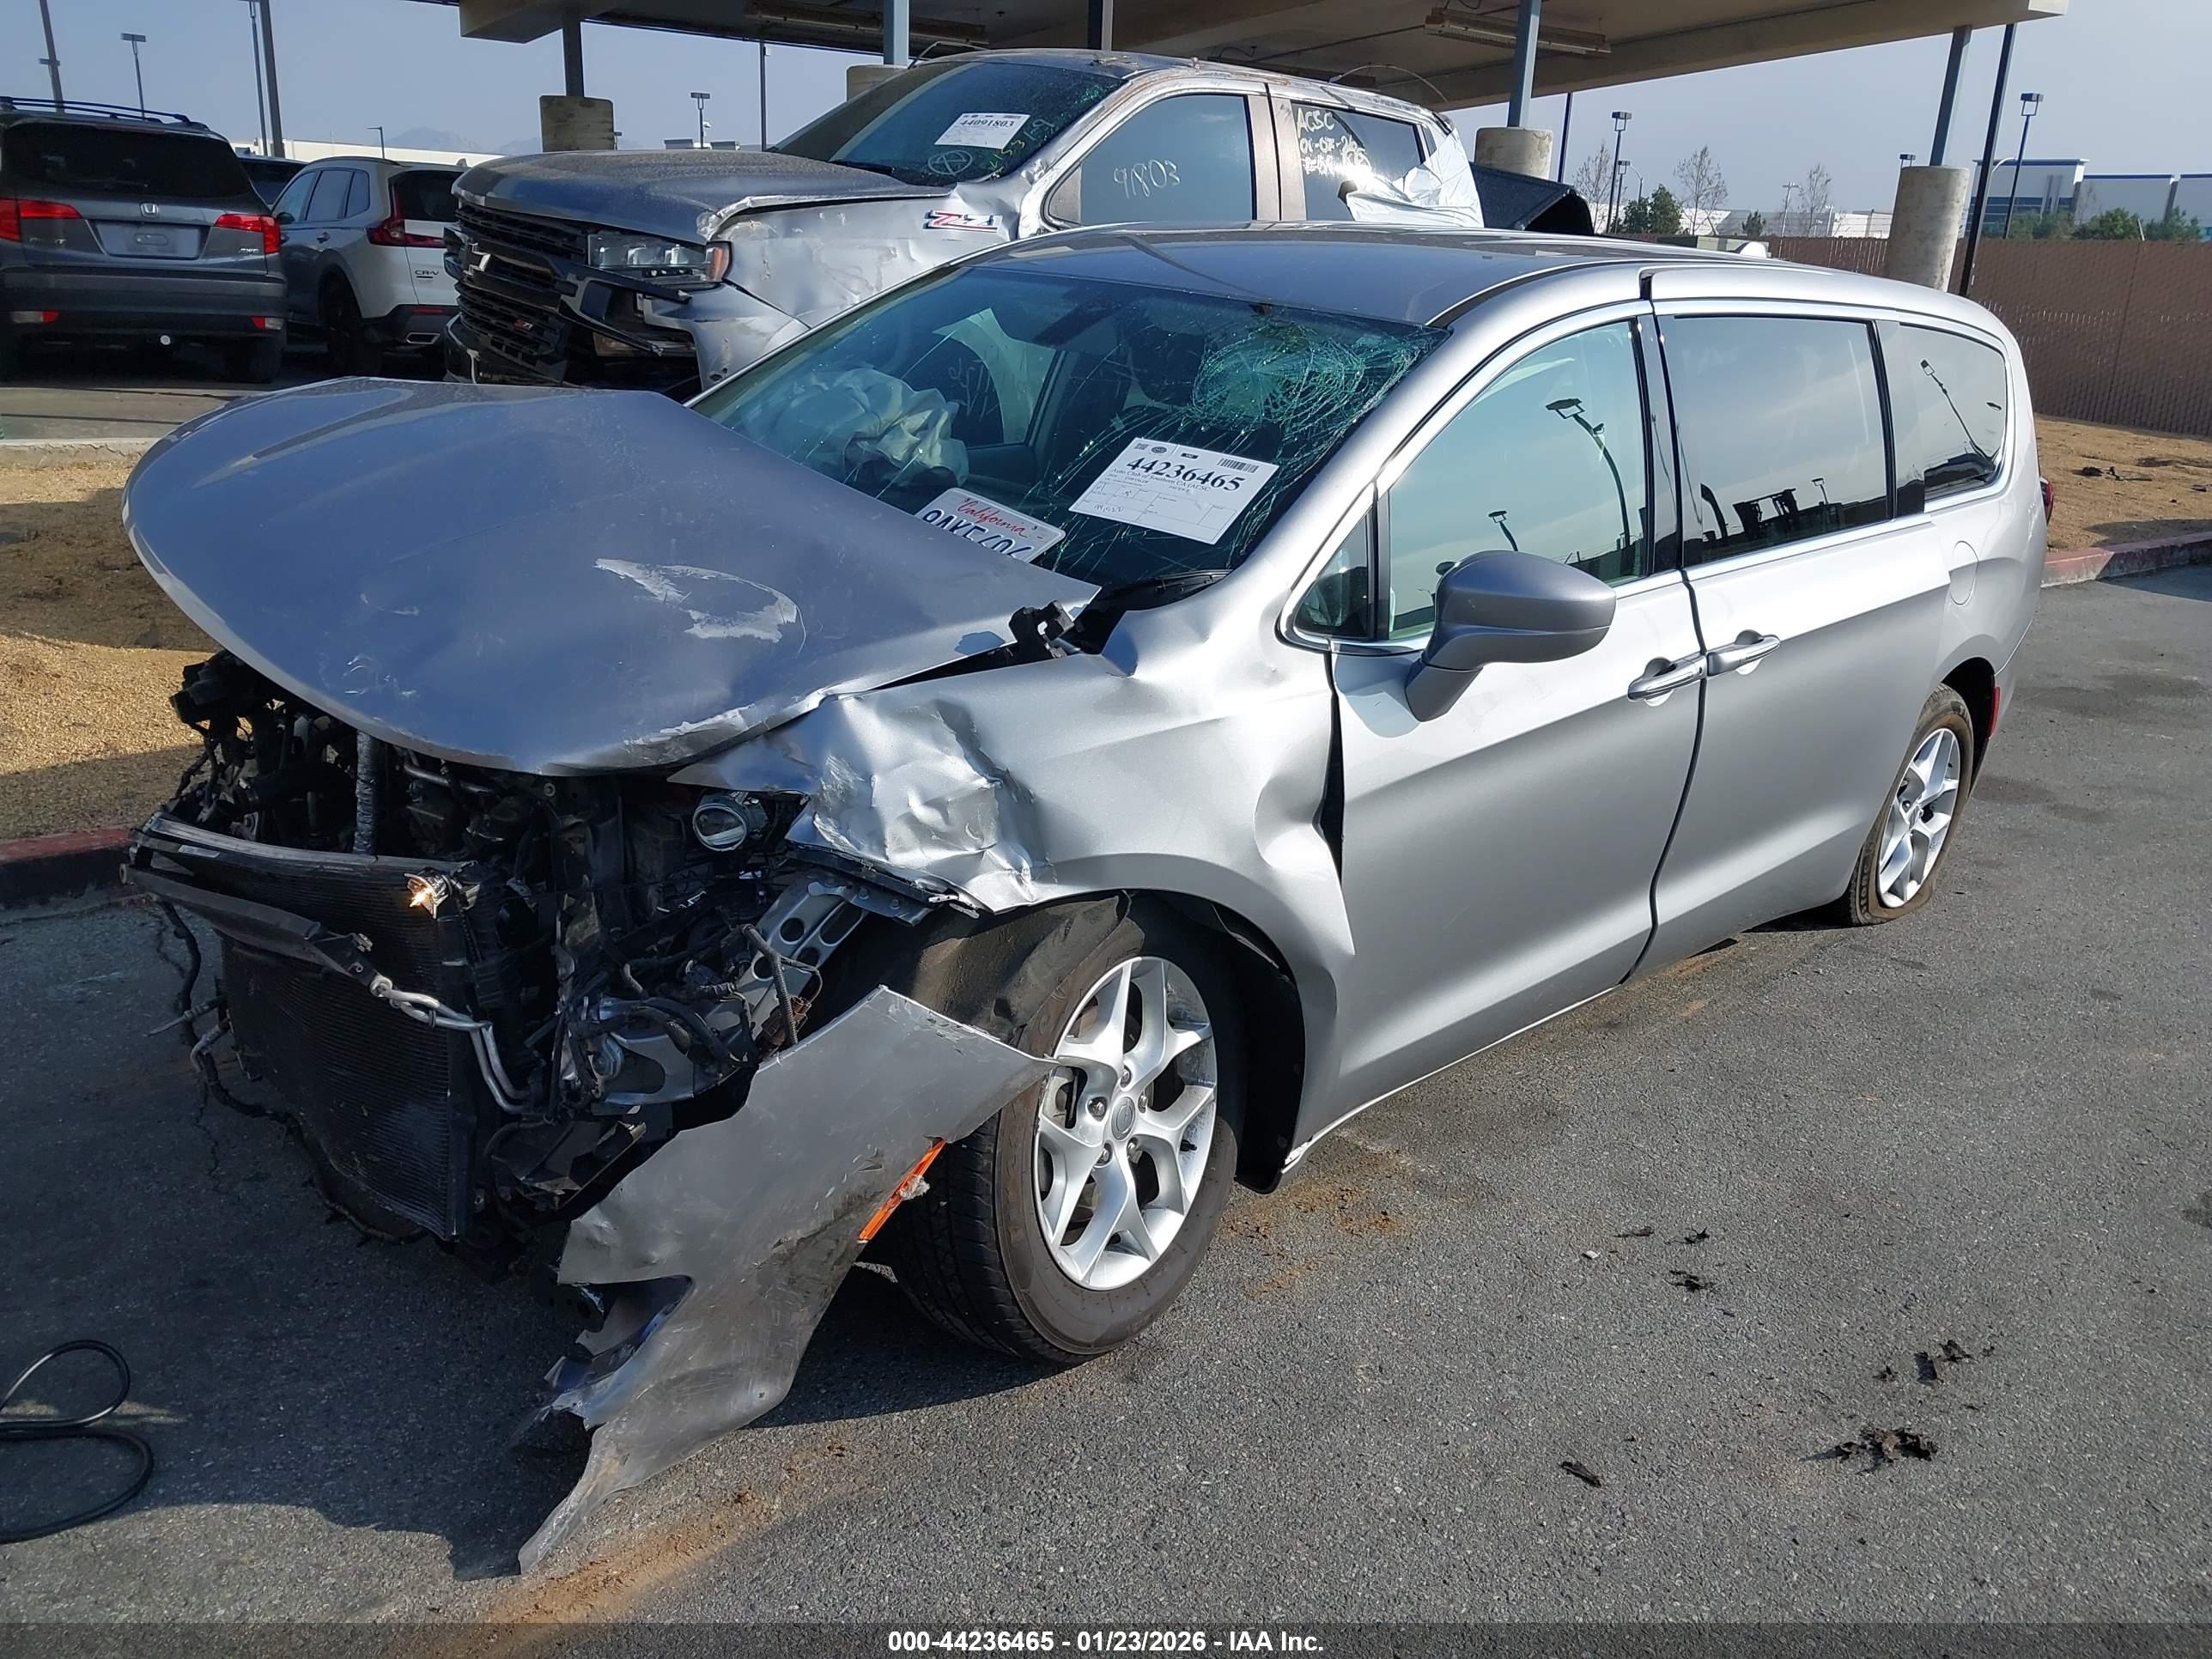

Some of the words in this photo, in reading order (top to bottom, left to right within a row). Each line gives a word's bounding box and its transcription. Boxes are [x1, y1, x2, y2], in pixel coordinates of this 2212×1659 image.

[1113, 159, 1181, 199] 91803
[1127, 457, 1246, 492] 44236465
[957, 500, 1028, 538] California
